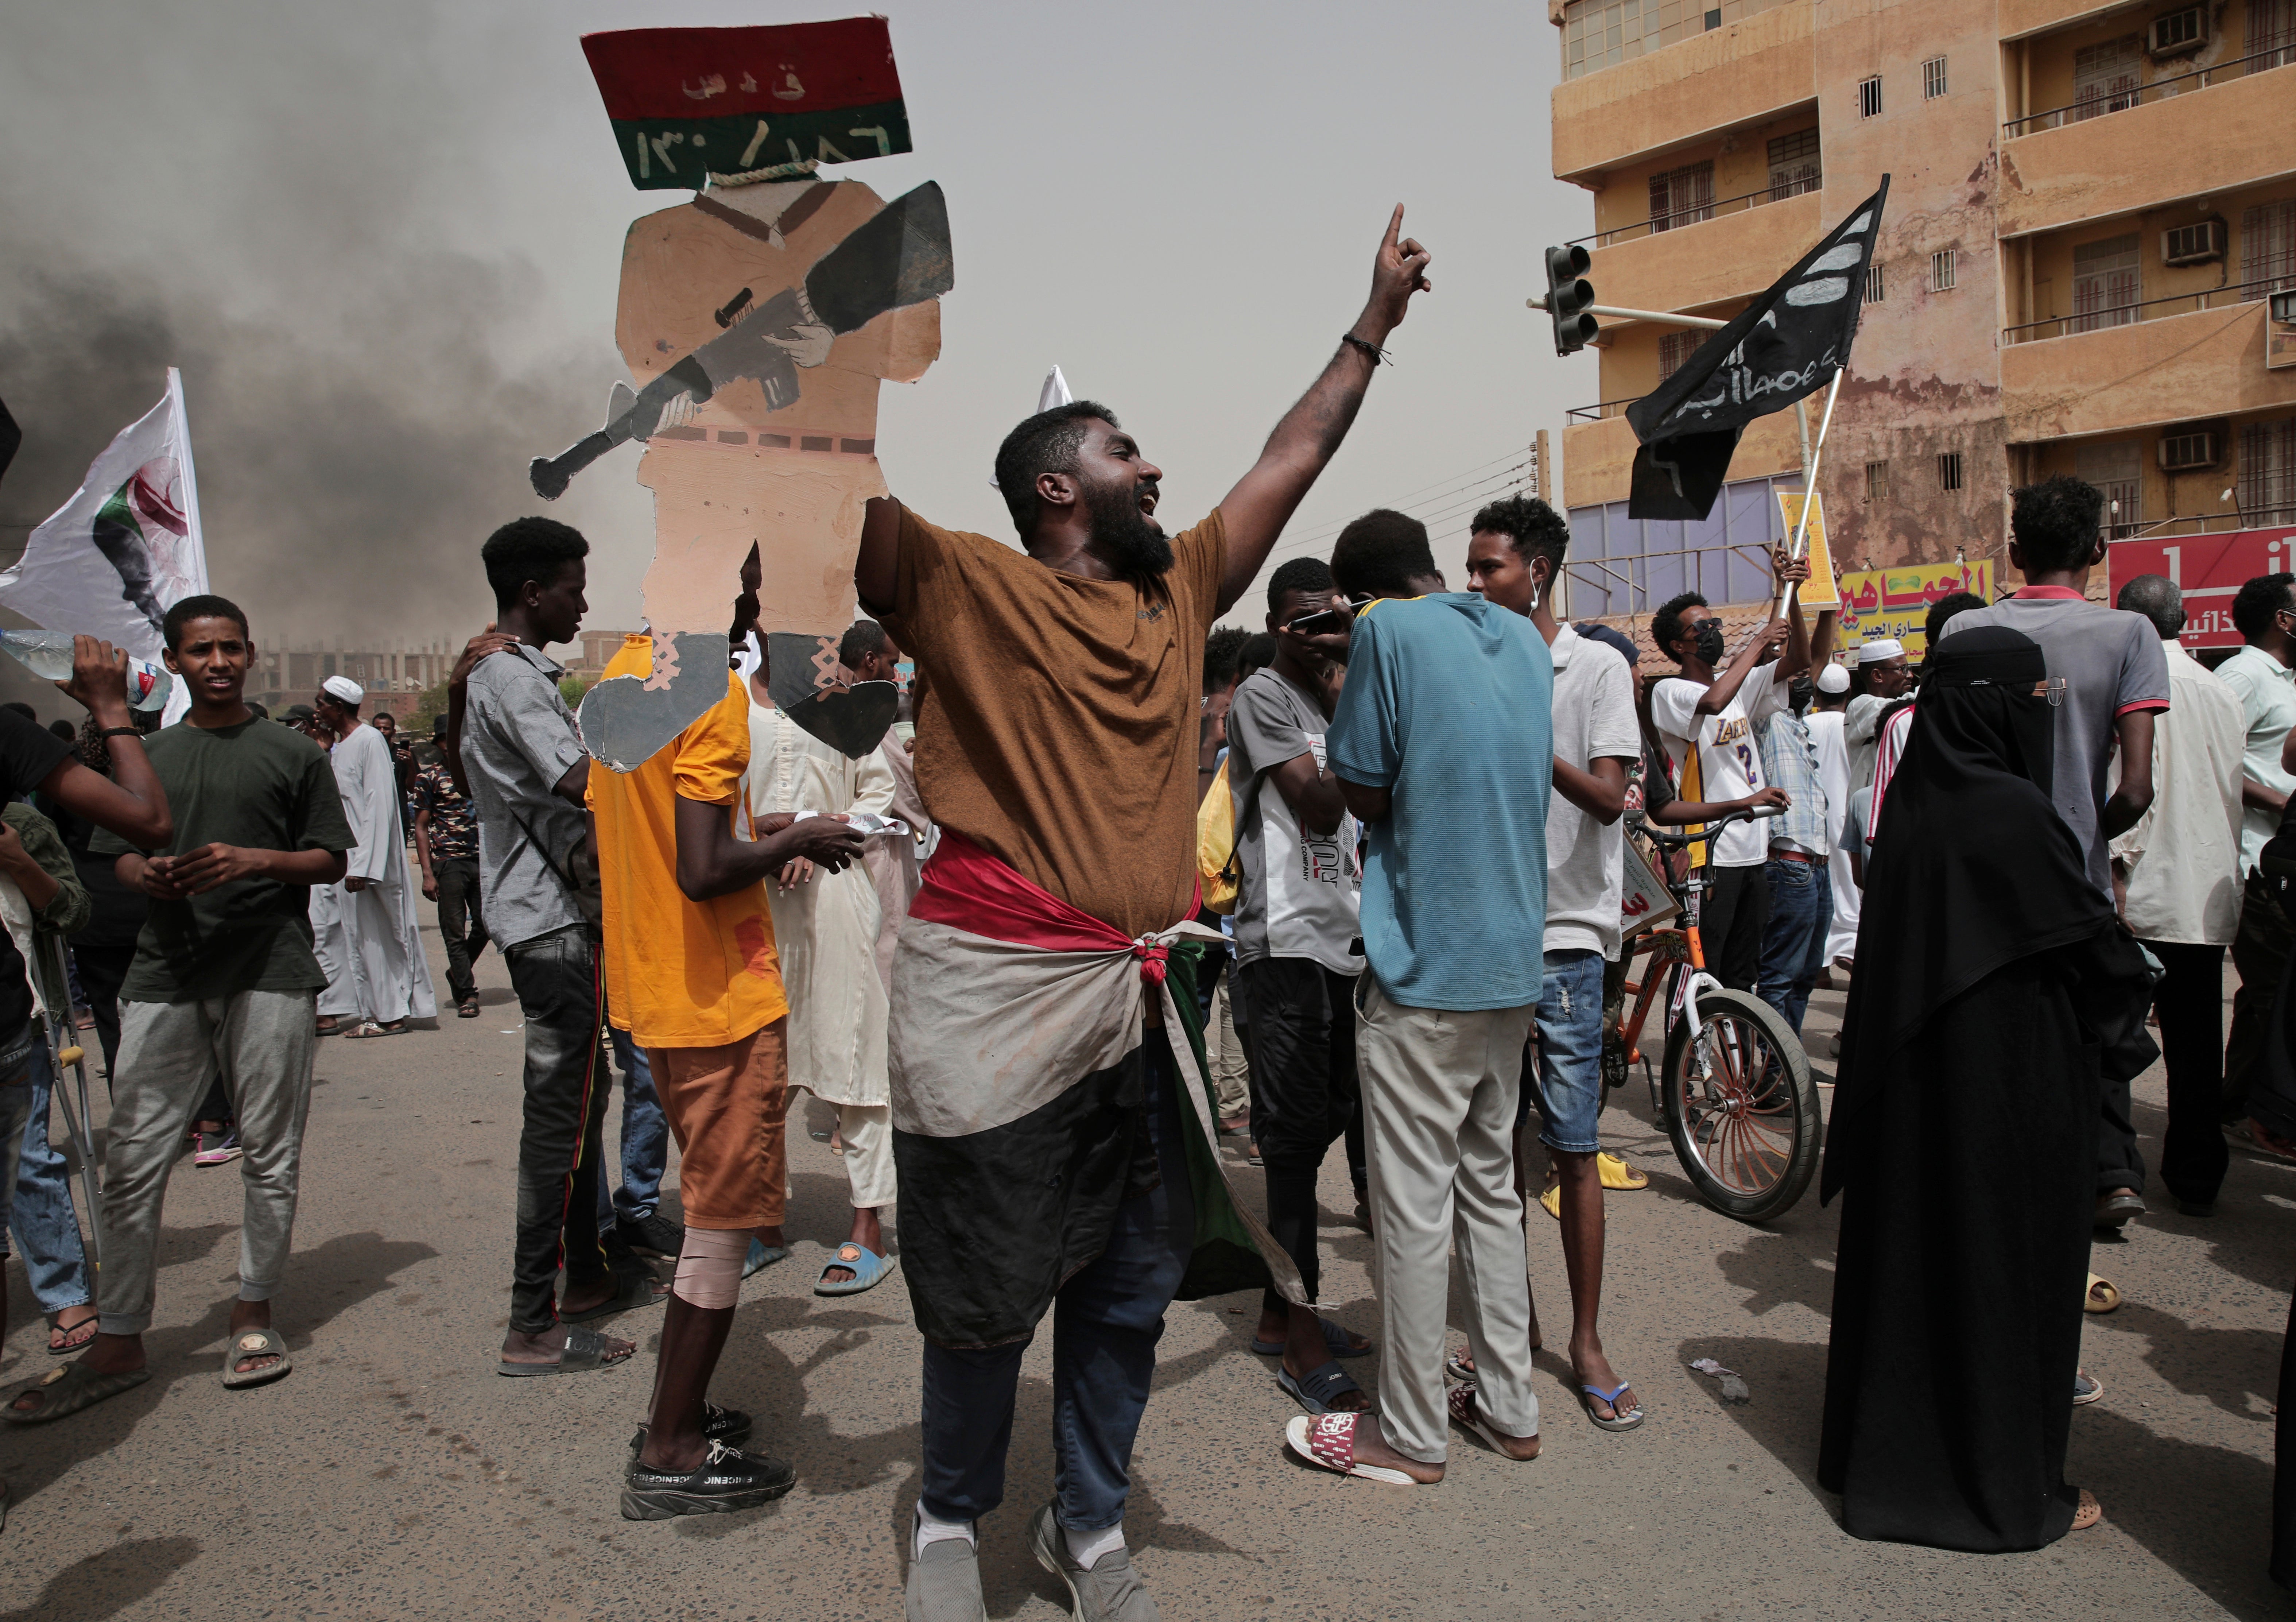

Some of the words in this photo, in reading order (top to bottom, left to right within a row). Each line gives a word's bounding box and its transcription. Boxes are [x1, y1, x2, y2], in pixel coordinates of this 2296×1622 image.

[1862, 621, 1891, 640] الجيد
[1735, 743, 1757, 786] 2
[1301, 846, 1309, 882] COMPANY
[1634, 961, 1655, 1017] TEJAS
